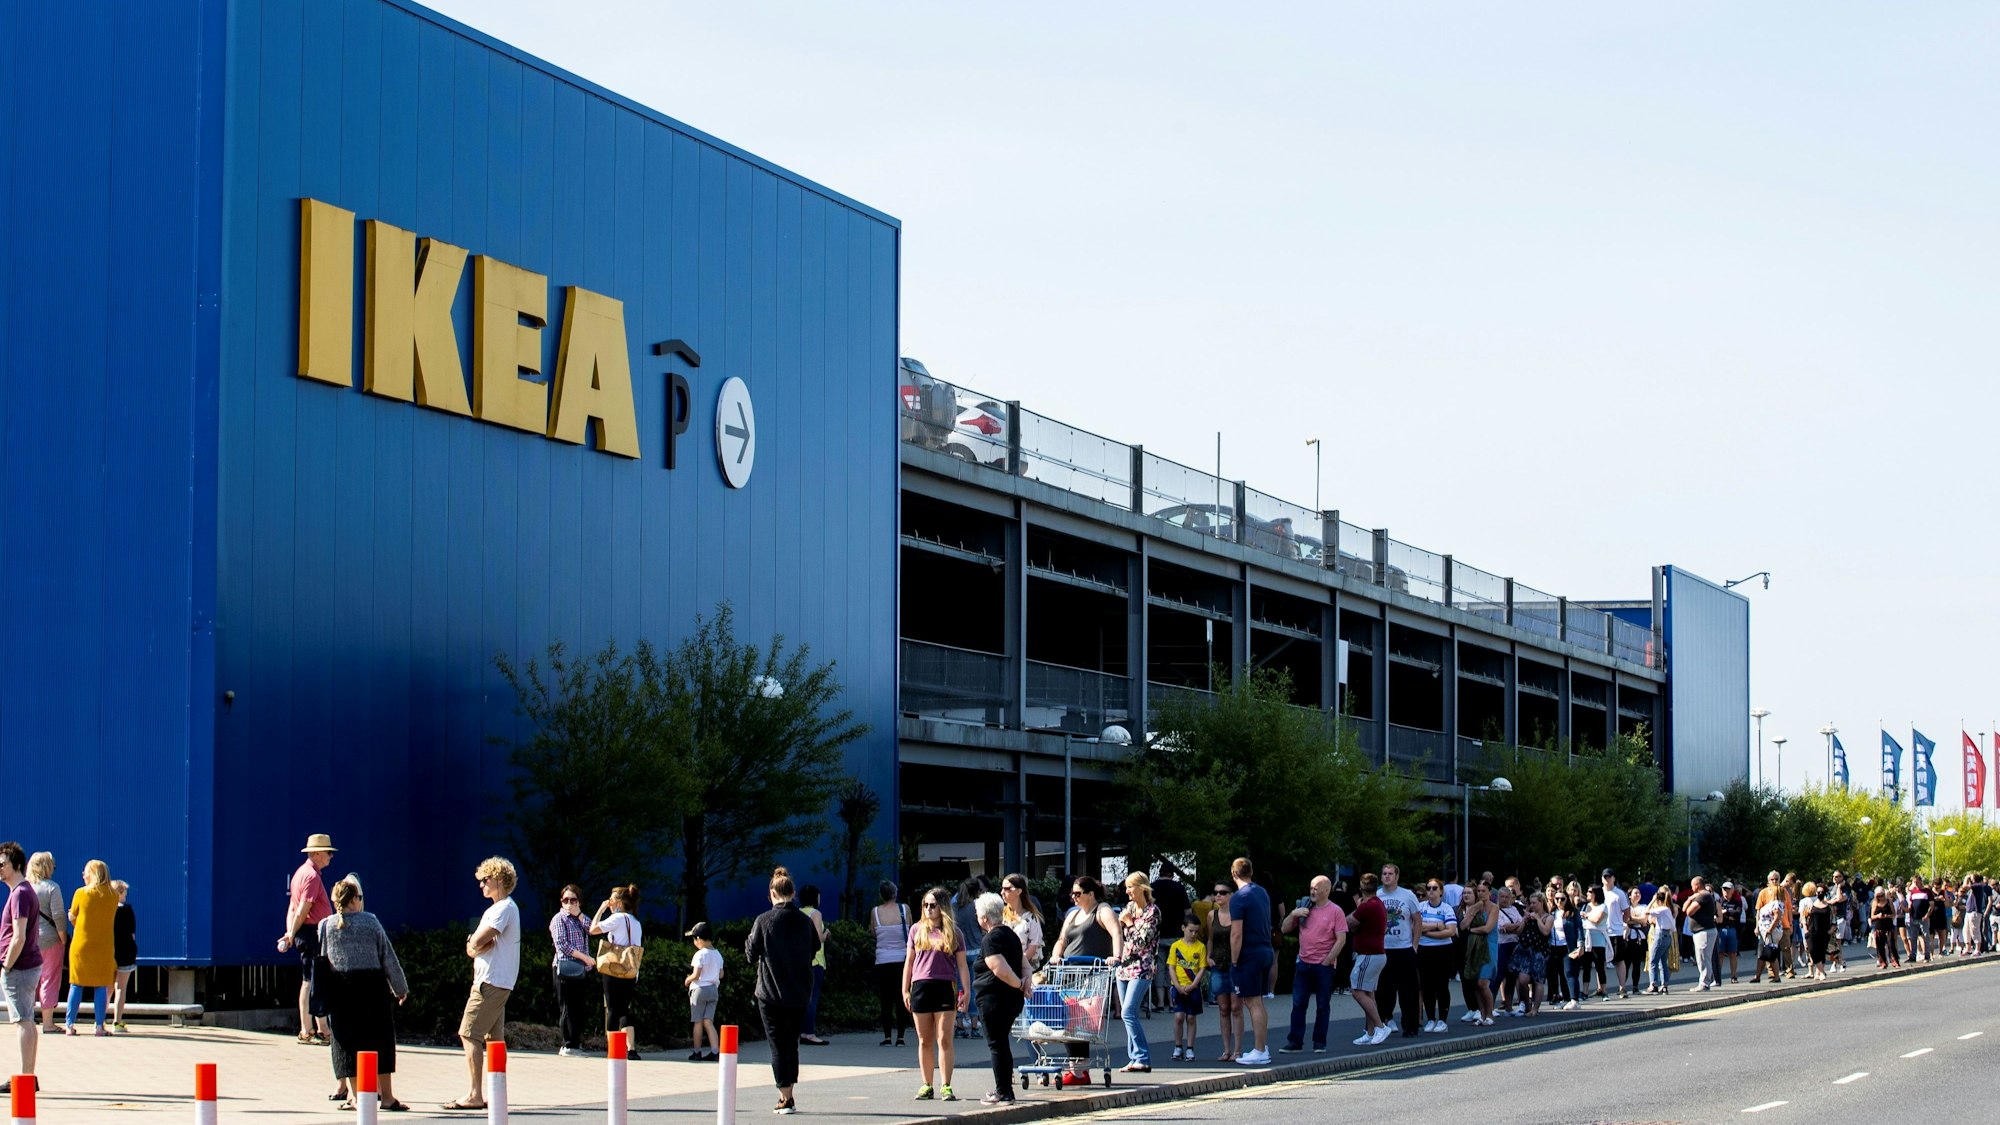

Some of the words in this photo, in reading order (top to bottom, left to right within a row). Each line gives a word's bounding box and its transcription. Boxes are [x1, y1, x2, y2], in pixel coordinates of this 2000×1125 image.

[298, 197, 640, 459] IKEA
[666, 372, 691, 470] P
[1916, 743, 1928, 802] IKEA
[1966, 745, 1977, 803] IKEA
[1385, 927, 1401, 935] AD
